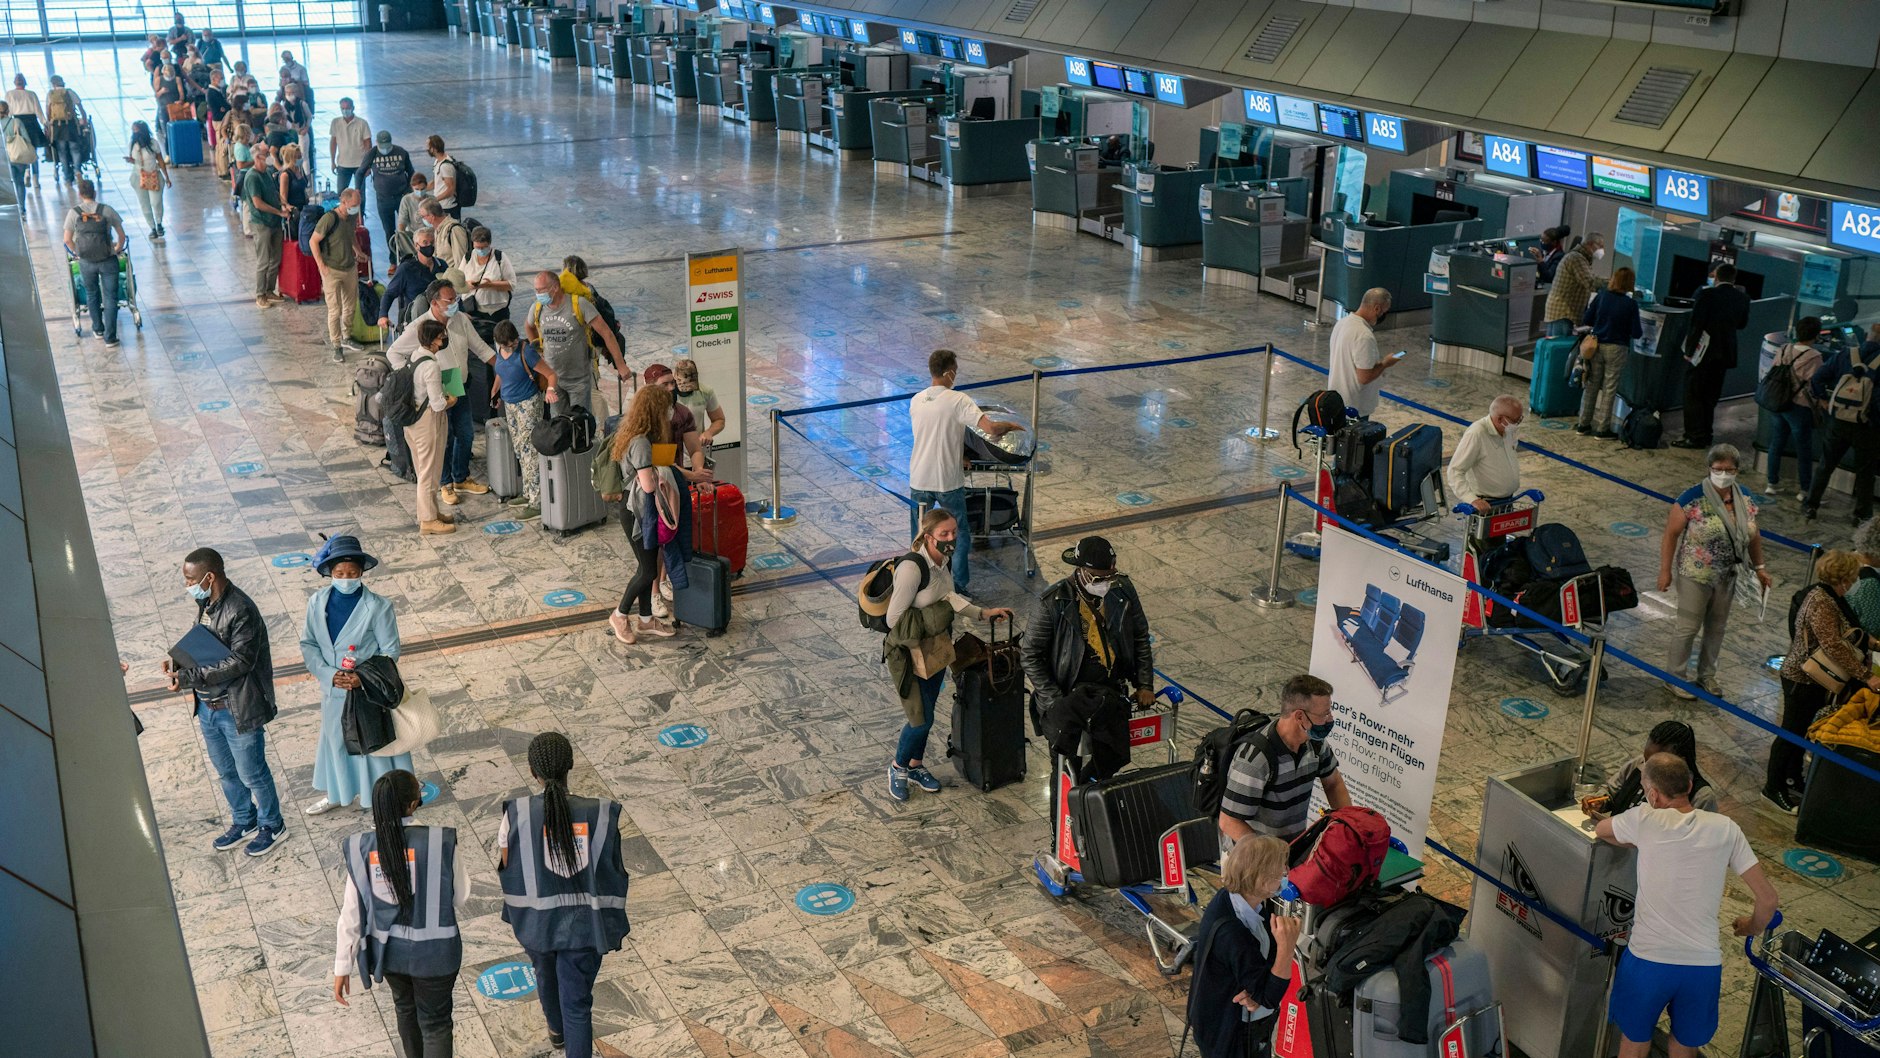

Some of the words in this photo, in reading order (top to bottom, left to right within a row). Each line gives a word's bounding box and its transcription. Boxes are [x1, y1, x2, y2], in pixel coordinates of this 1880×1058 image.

[853, 22, 865, 36] A91
[902, 30, 916, 45] A90
[967, 42, 982, 57] A89
[1069, 60, 1087, 77] A88
[1160, 77, 1178, 94] A87
[1250, 94, 1271, 113] A86
[1372, 117, 1397, 139] A85
[1491, 141, 1521, 165] A84
[1598, 178, 1627, 190] Economy
[1627, 185, 1646, 194] Class
[1664, 175, 1700, 201] A83
[1841, 210, 1880, 240] A82
[704, 266, 733, 275] Lufthansa
[708, 290, 734, 300] SWISS
[545, 315, 574, 331] SUPERIOR
[695, 312, 733, 323] Economy
[695, 323, 719, 332] Class
[696, 337, 731, 349] Check-in
[1406, 574, 1454, 603] Lufthansa
[1359, 712, 1386, 734] Row:
[1387, 728, 1415, 749] mehr
[1335, 717, 1353, 732] auf
[1352, 725, 1389, 751] langen
[1390, 743, 1425, 771] Flügen
[1351, 739, 1377, 760] Row:
[1379, 755, 1404, 775] more
[1334, 747, 1347, 760] on
[1348, 752, 1370, 774] long
[1371, 764, 1402, 789] flights
[1169, 852, 1177, 875] SPAR
[1498, 891, 1529, 920] EYE
[1285, 1015, 1296, 1044] SPAR
